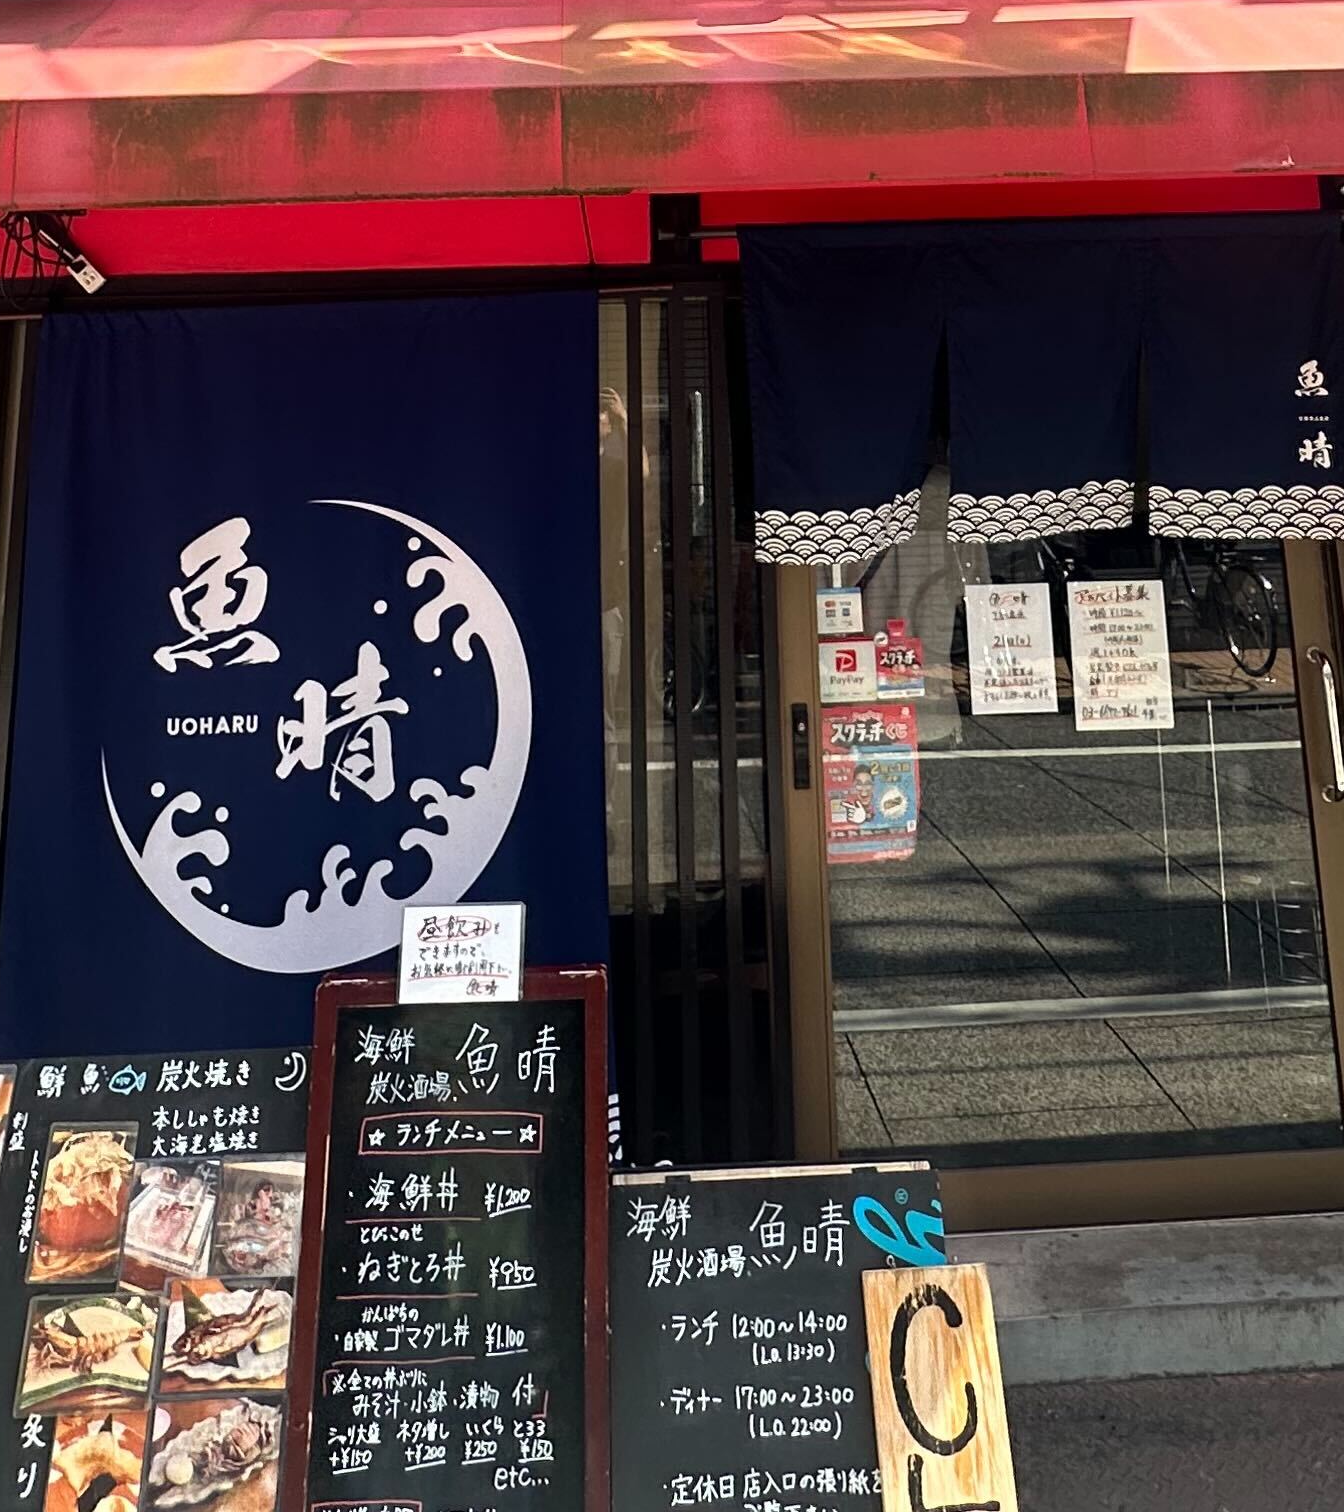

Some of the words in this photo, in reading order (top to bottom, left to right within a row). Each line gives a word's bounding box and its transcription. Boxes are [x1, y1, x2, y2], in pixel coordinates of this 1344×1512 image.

[153, 516, 409, 801] 魚晴
[829, 674, 864, 685] PayPay
[166, 714, 259, 737] UOHARU
[354, 1024, 416, 1066] 海鮮
[455, 1022, 561, 1095] 魚晴
[155, 1058, 251, 1093] 炭火焼き
[365, 1166, 459, 1212] 海鮮丼
[625, 1194, 692, 1241] 海鮮
[749, 1199, 851, 1270] 魚晴
[489, 1256, 536, 1288] ¥950
[671, 1310, 719, 1346] ランチ
[511, 1373, 536, 1406] 付
[465, 1416, 505, 1436] いくら
[17, 1413, 46, 1499] 炙り
[464, 1439, 498, 1459] ¥250
[519, 1439, 554, 1459] ¥150
[671, 1472, 735, 1506] 定休日
